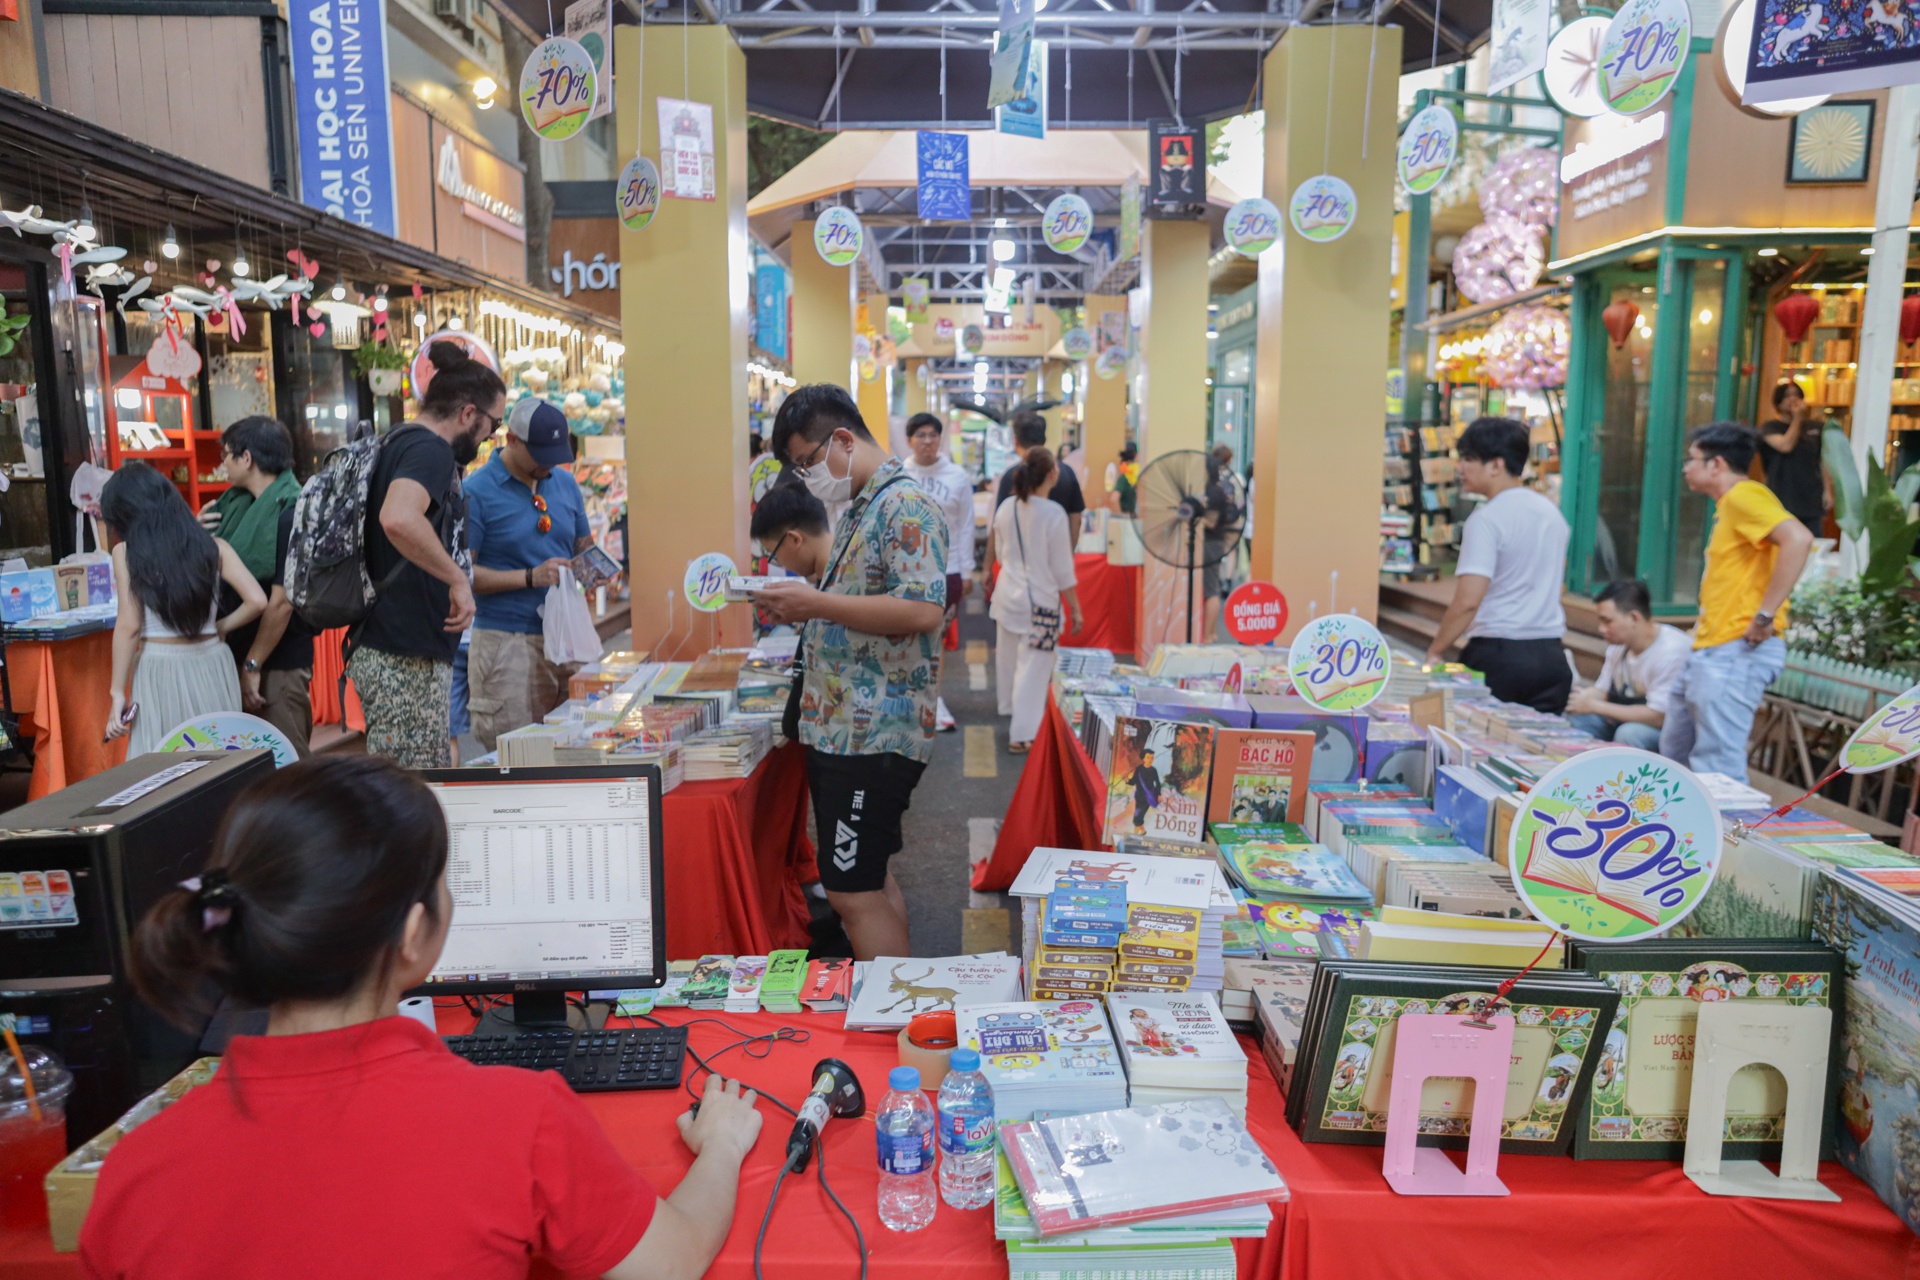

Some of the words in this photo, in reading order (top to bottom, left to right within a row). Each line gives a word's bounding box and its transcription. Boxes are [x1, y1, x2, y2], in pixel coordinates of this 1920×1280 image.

[309, 1, 336, 79] HOA
[1602, 21, 1681, 78] -70%
[526, 65, 590, 110] -70%
[315, 86, 346, 161] HỌC
[346, 103, 369, 160] SEN
[1402, 129, 1451, 168] -50%
[350, 165, 374, 228] HOA
[618, 177, 657, 208] -50%
[1295, 194, 1349, 219] -70%
[819, 223, 858, 246] -70%
[1045, 210, 1088, 235] -50%
[1227, 212, 1278, 237] -50%
[1233, 600, 1262, 618] ĐỒNG
[1263, 599, 1281, 615] GIÁ
[1295, 638, 1385, 685] -30%
[851, 790, 865, 811] THE
[1164, 797, 1198, 816] Kim
[1154, 814, 1198, 837] Đồng
[1531, 799, 1702, 908] -30%
[1171, 1009, 1211, 1017] CON
[1653, 1033, 1685, 1048] LƯỢC
[1687, 1035, 1696, 1046] S
